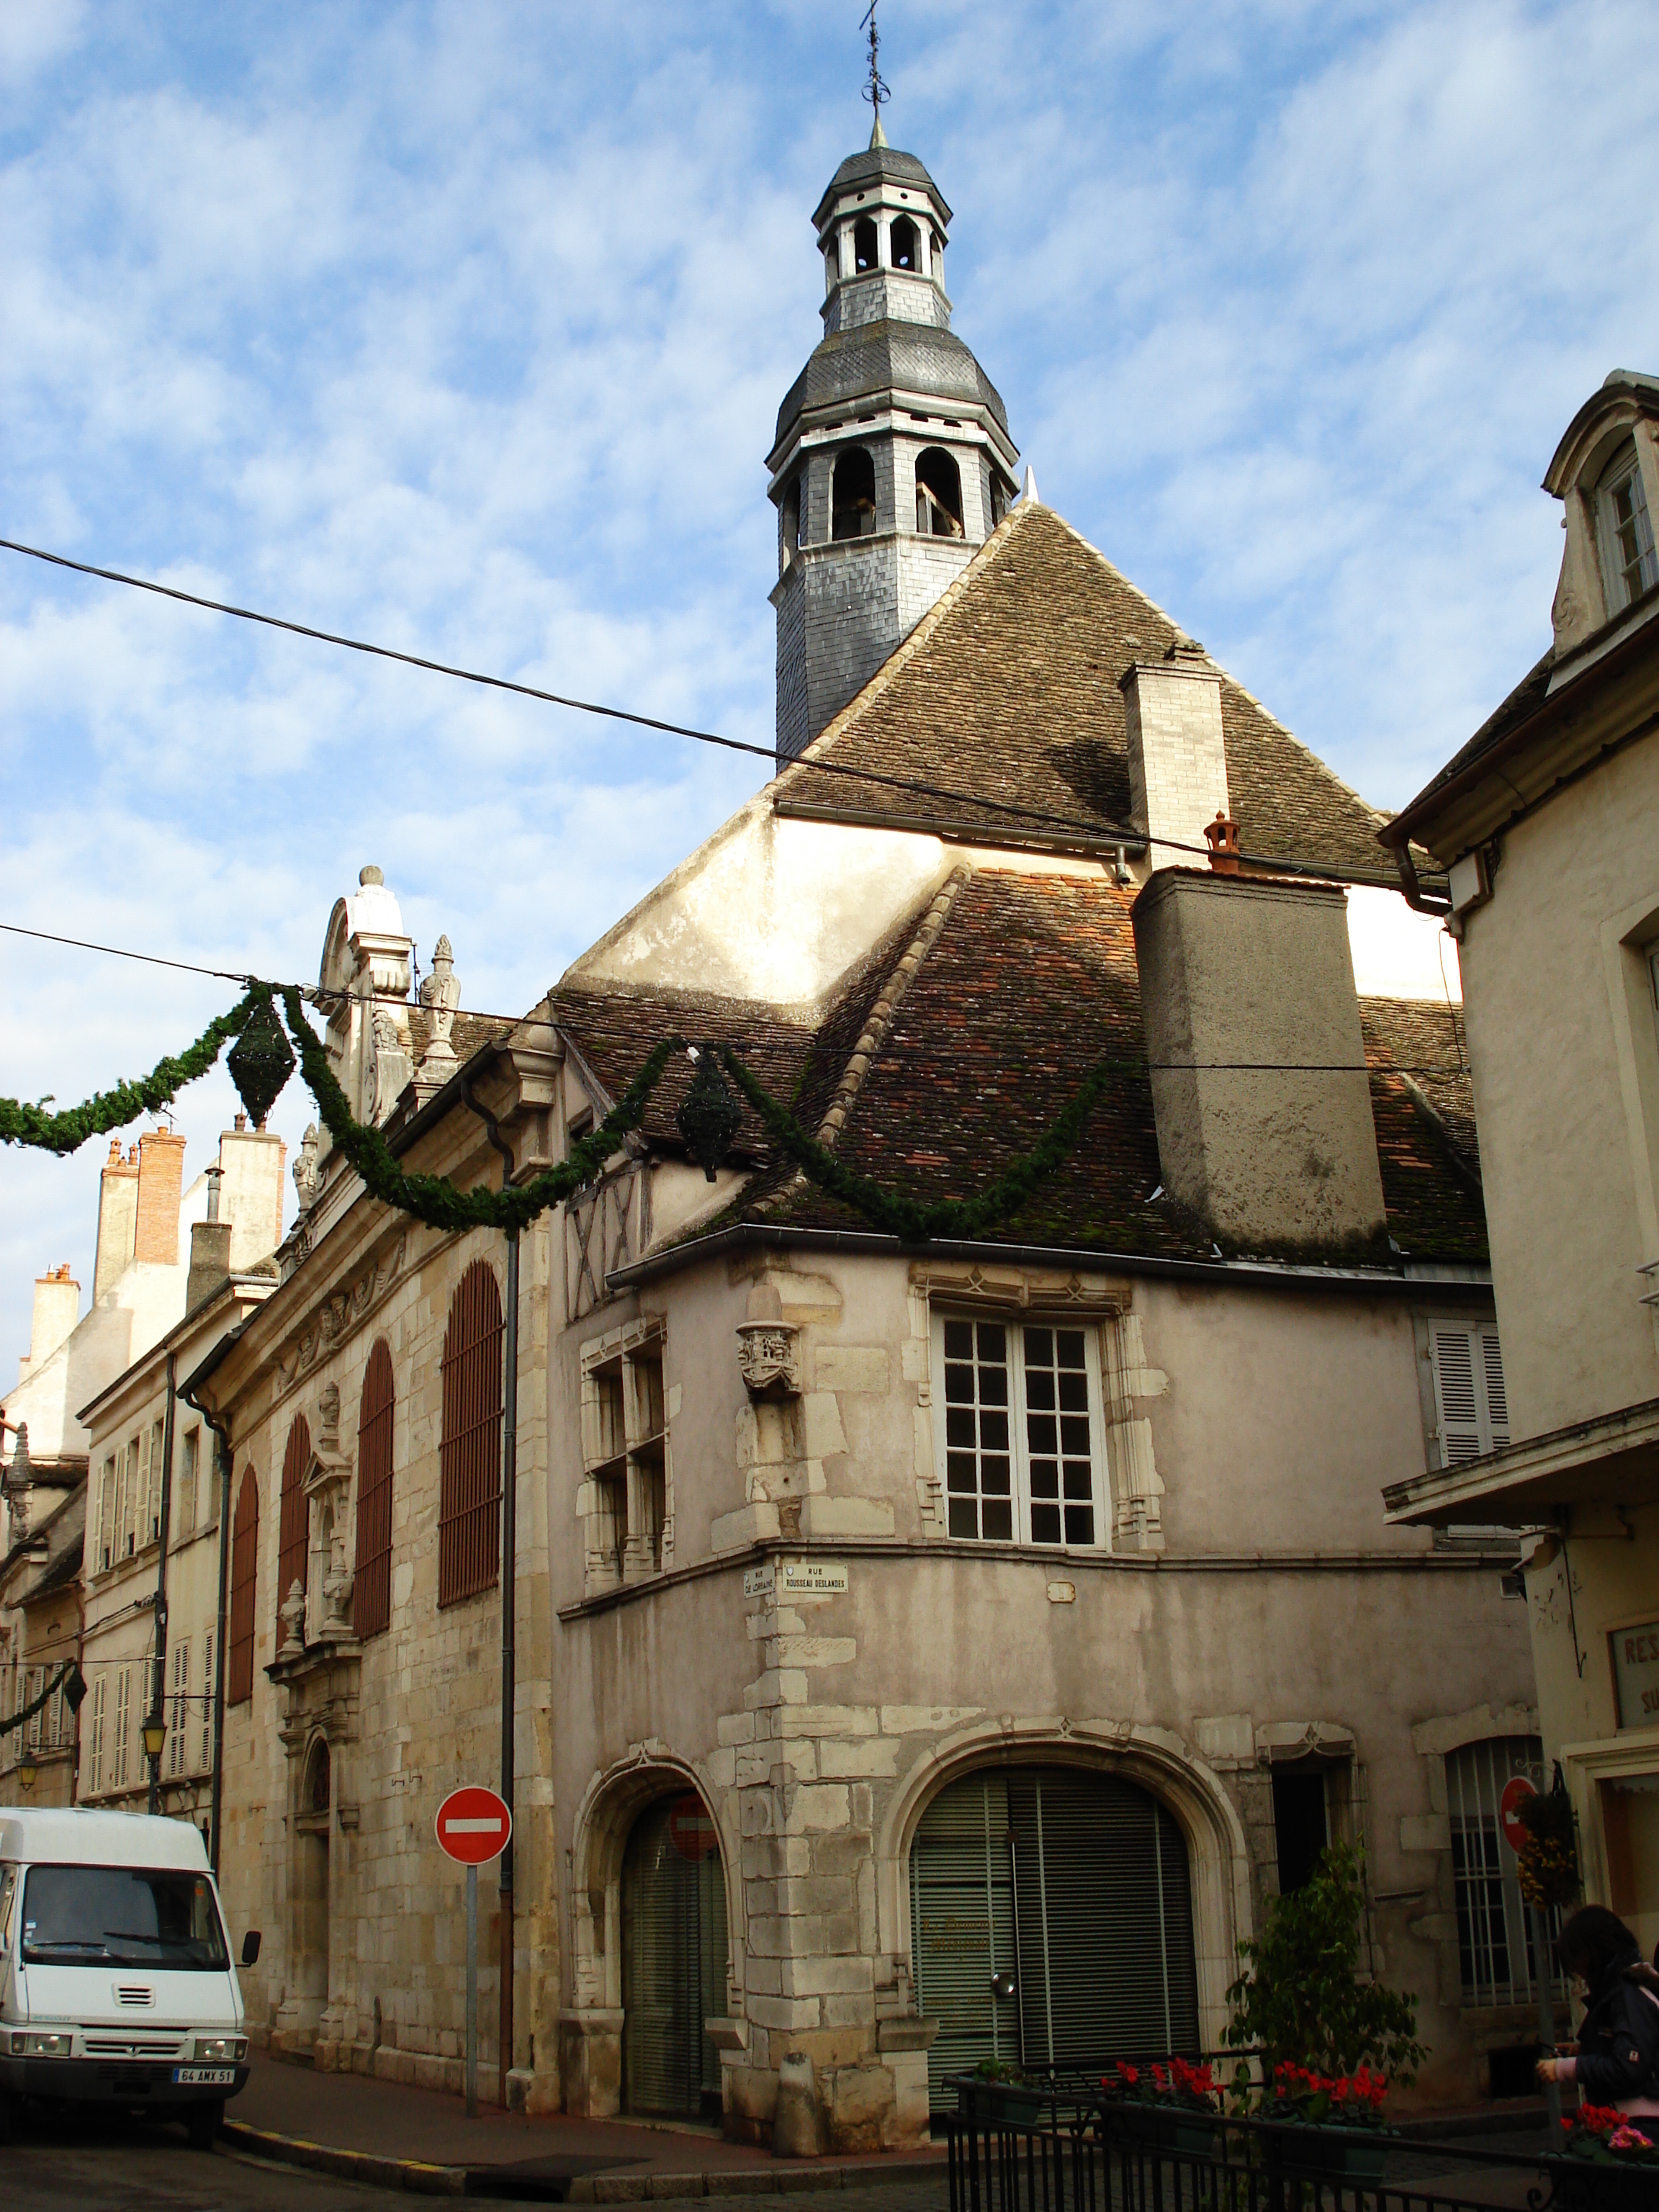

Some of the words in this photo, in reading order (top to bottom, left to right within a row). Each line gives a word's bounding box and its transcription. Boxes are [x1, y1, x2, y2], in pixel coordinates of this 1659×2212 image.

[753, 1579, 773, 1591] LORRAINE
[786, 1579, 813, 1588] ROUSSEAU
[1624, 1632, 1659, 1665] RES
[182, 2070, 194, 2081] 64
[197, 2071, 216, 2082] AMX
[219, 2071, 230, 2082] 51
